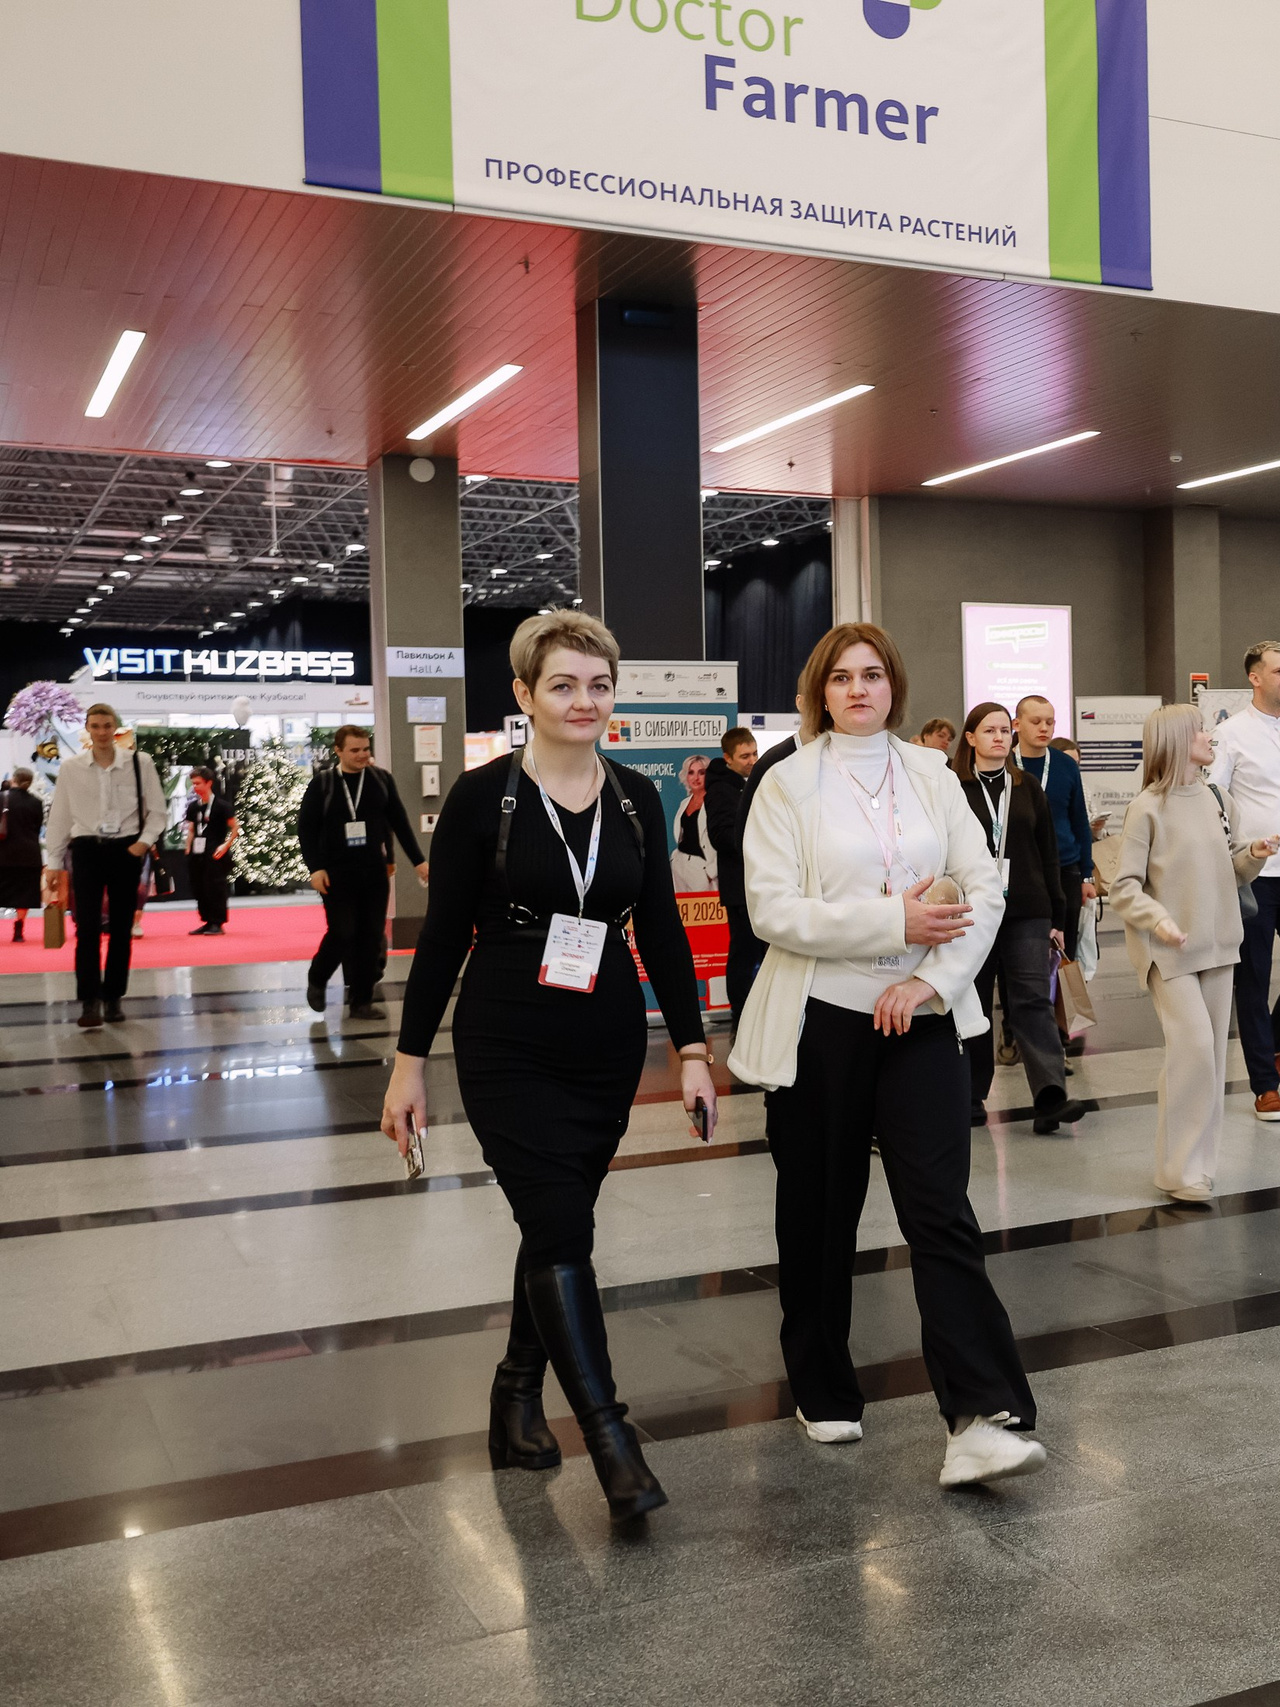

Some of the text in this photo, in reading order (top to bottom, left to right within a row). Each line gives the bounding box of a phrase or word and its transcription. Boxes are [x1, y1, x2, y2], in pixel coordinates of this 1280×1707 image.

[704, 53, 940, 145] Farmer
[485, 157, 1017, 248] ПРОФЕССИОНАЛЬНАЯ ЗАЩИТА РАСТЕНИЙ
[83, 647, 355, 677] VISIT KUZBASS
[396, 650, 446, 660] Павильон
[409, 664, 443, 674] Hall A
[198, 693, 258, 702] притяжие
[634, 720, 722, 737] В СИБИРИ-ЕСТЬ!
[693, 901, 724, 921] 2026
